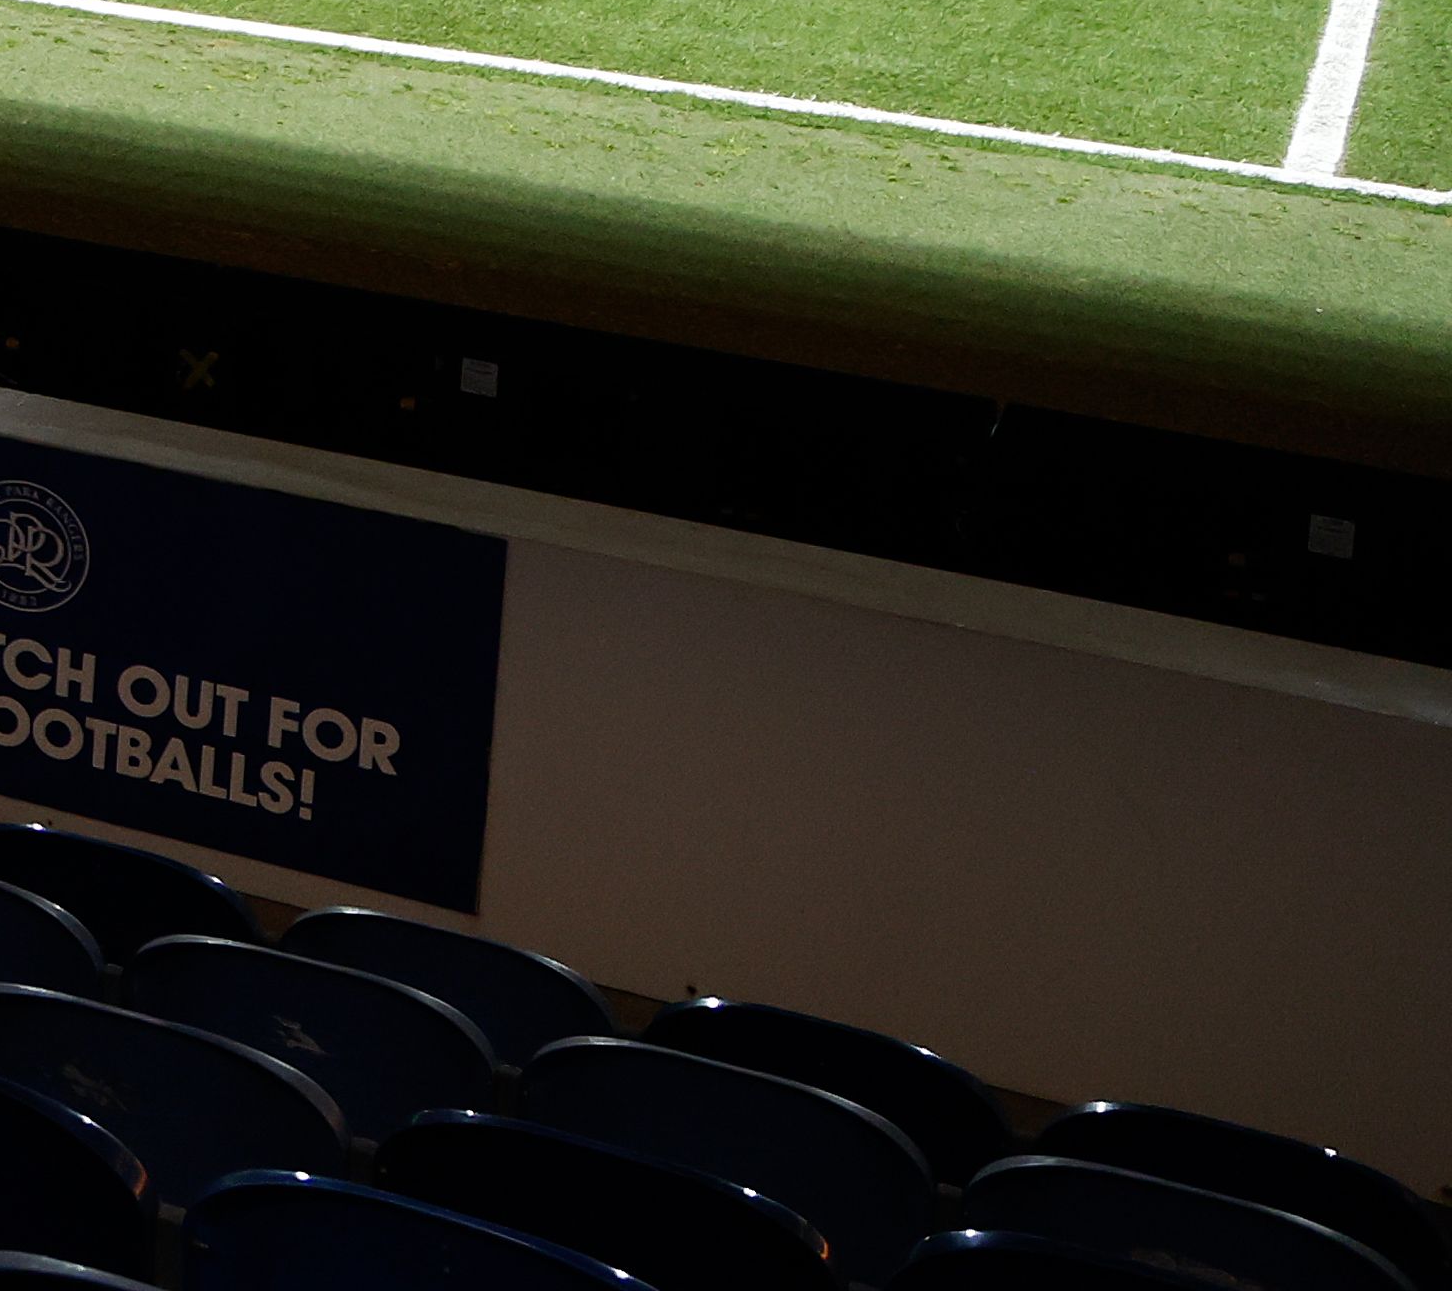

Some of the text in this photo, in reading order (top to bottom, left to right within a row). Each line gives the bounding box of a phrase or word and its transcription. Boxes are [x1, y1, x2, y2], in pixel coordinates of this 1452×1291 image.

[4, 486, 40, 500] PARK
[116, 664, 249, 739] OUT
[266, 696, 402, 778] FOR
